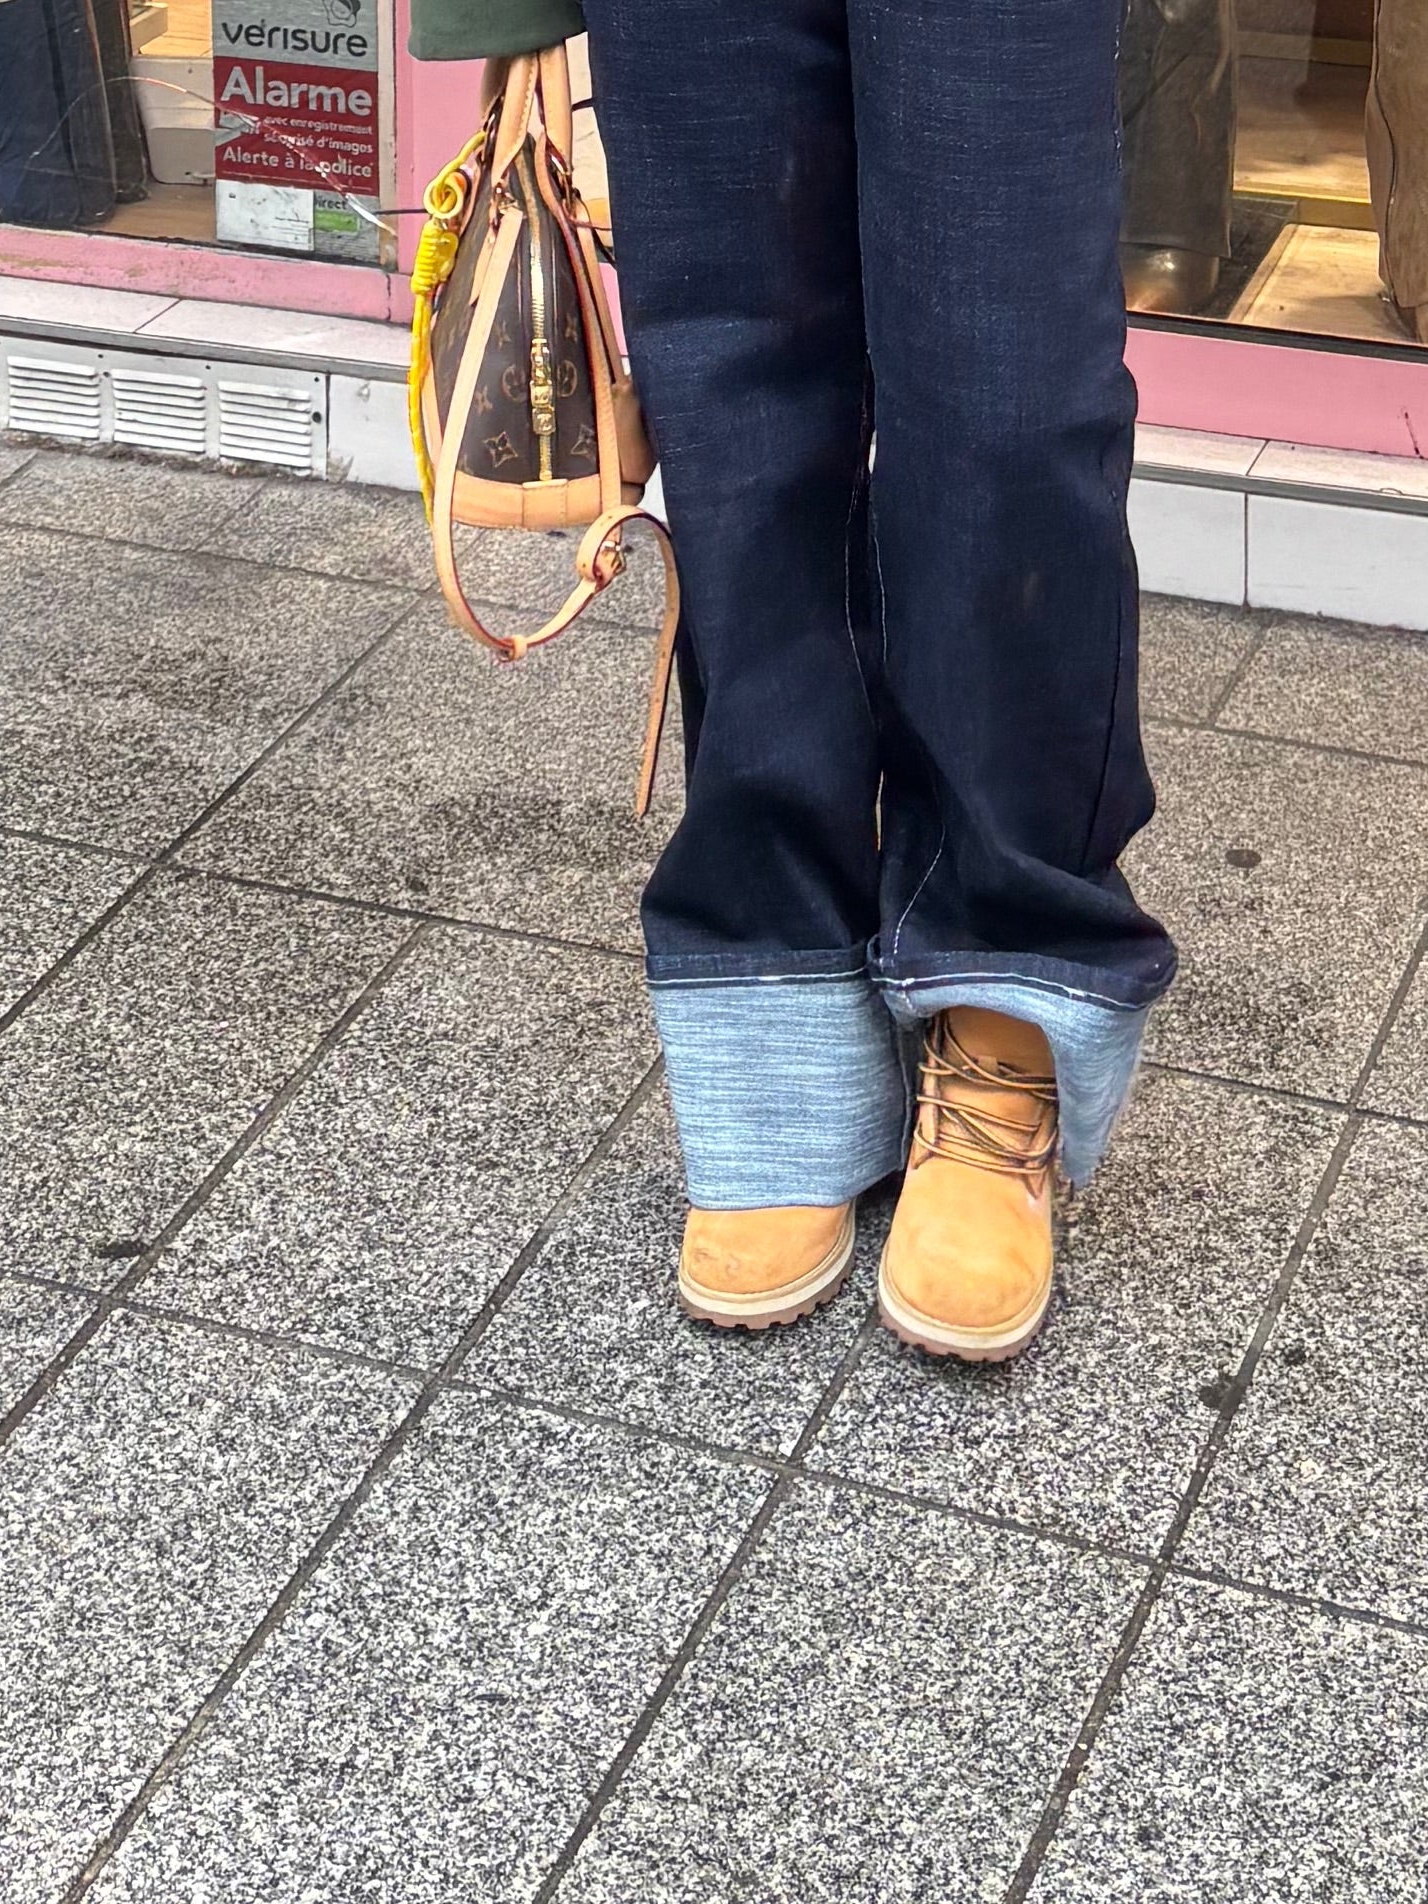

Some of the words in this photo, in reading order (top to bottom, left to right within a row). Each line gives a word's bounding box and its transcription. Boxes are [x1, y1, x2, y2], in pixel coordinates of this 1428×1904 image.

[221, 18, 368, 58] verisure
[220, 65, 373, 117] Alarme
[262, 116, 288, 127] avec
[289, 118, 373, 134] enregistrement
[316, 136, 374, 155] d'images
[222, 146, 279, 167] Alerte
[284, 152, 296, 169] à
